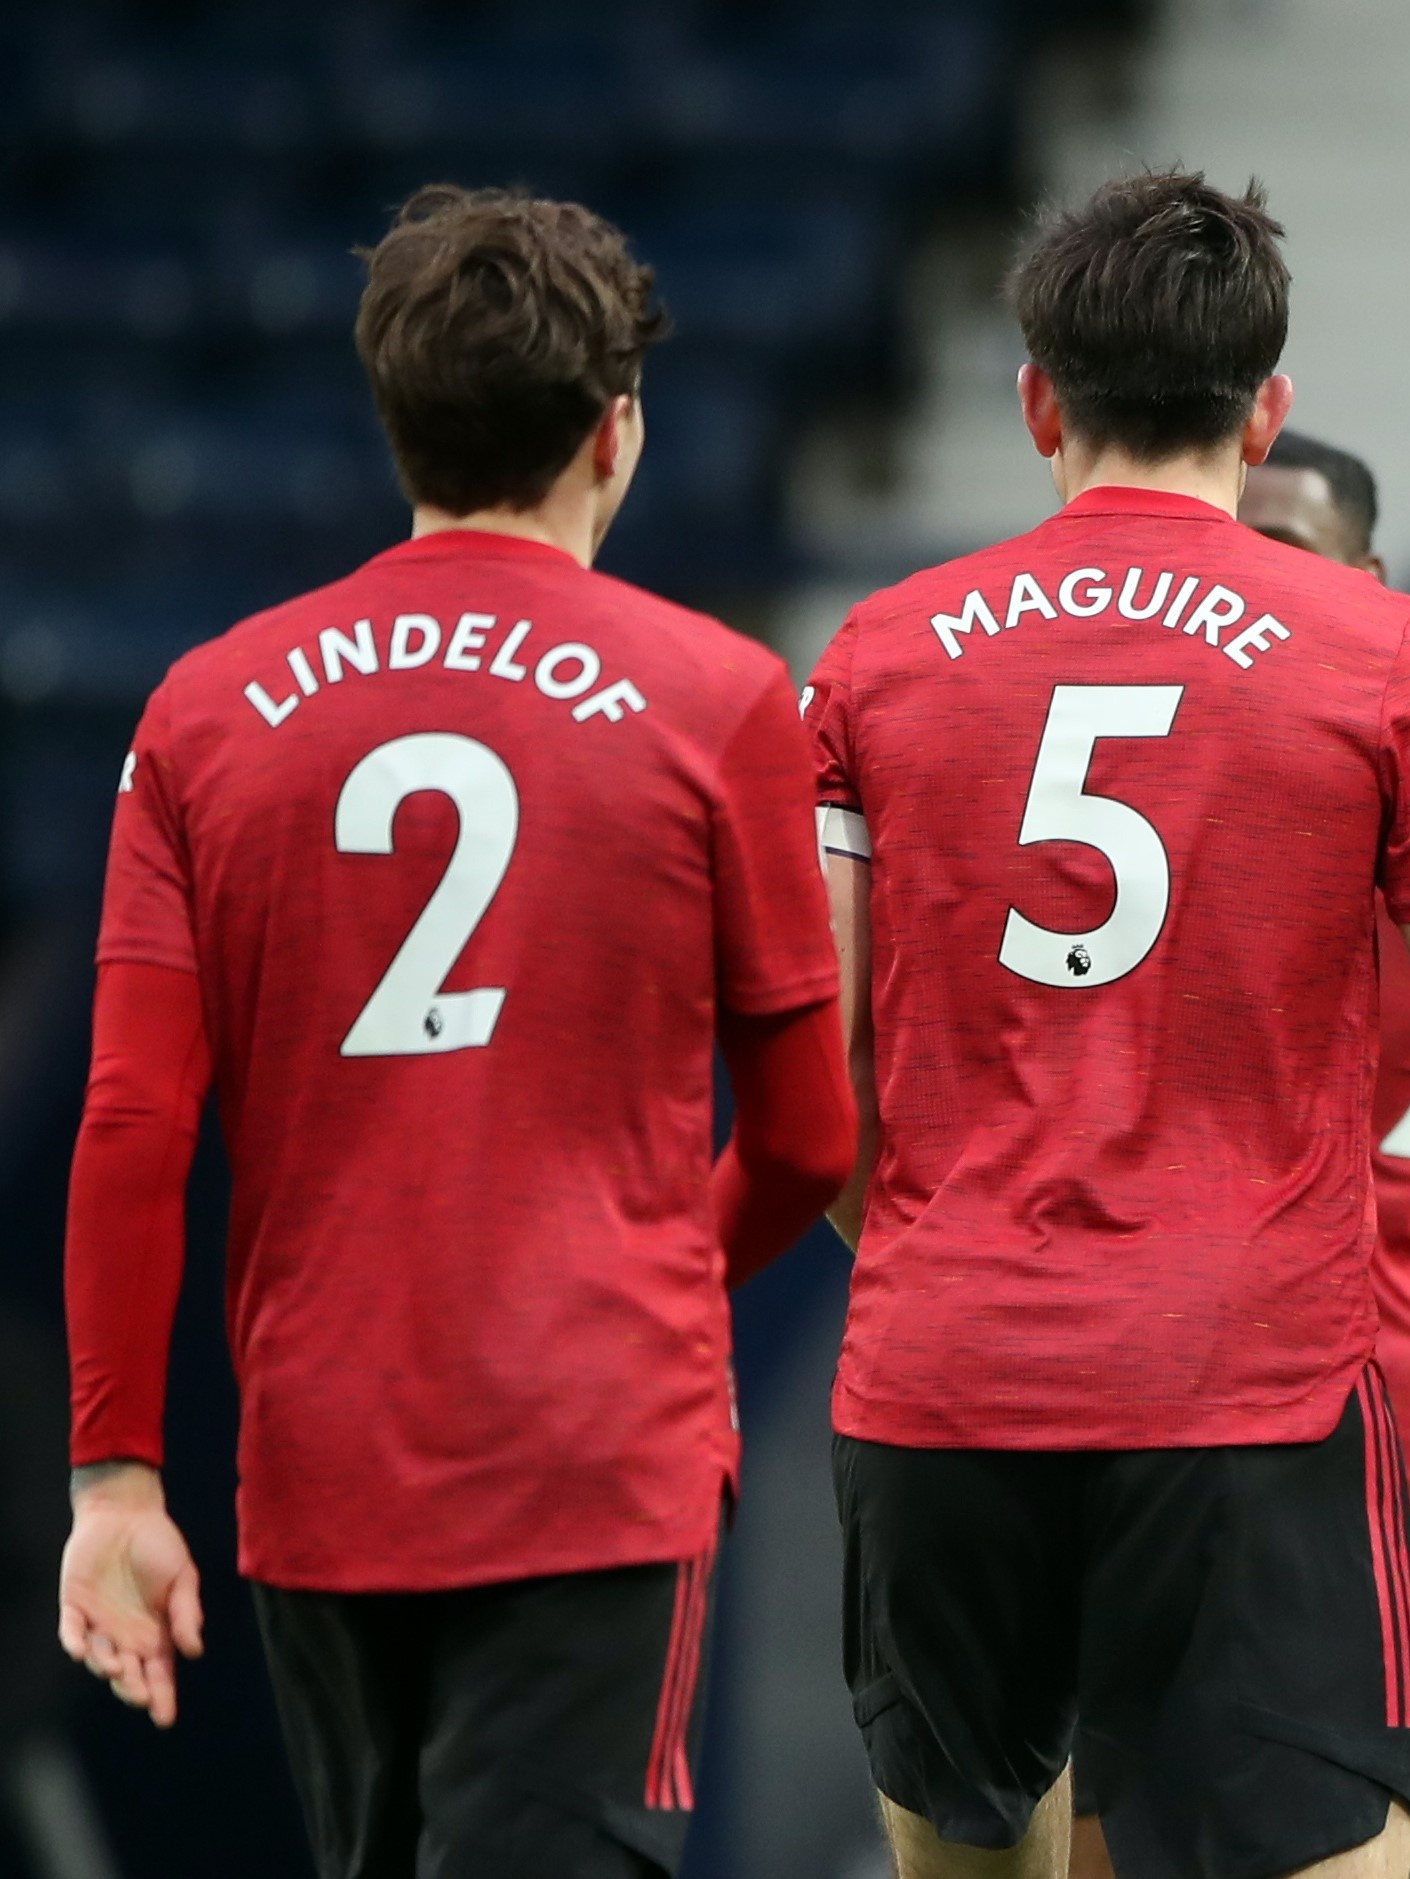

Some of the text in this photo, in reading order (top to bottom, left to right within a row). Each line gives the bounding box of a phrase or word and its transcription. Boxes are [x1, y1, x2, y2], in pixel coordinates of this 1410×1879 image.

[244, 612, 647, 728] LINDELOF
[930, 567, 1291, 670] MAGUIRE
[334, 731, 519, 1057] 2
[998, 684, 1185, 989] 5
